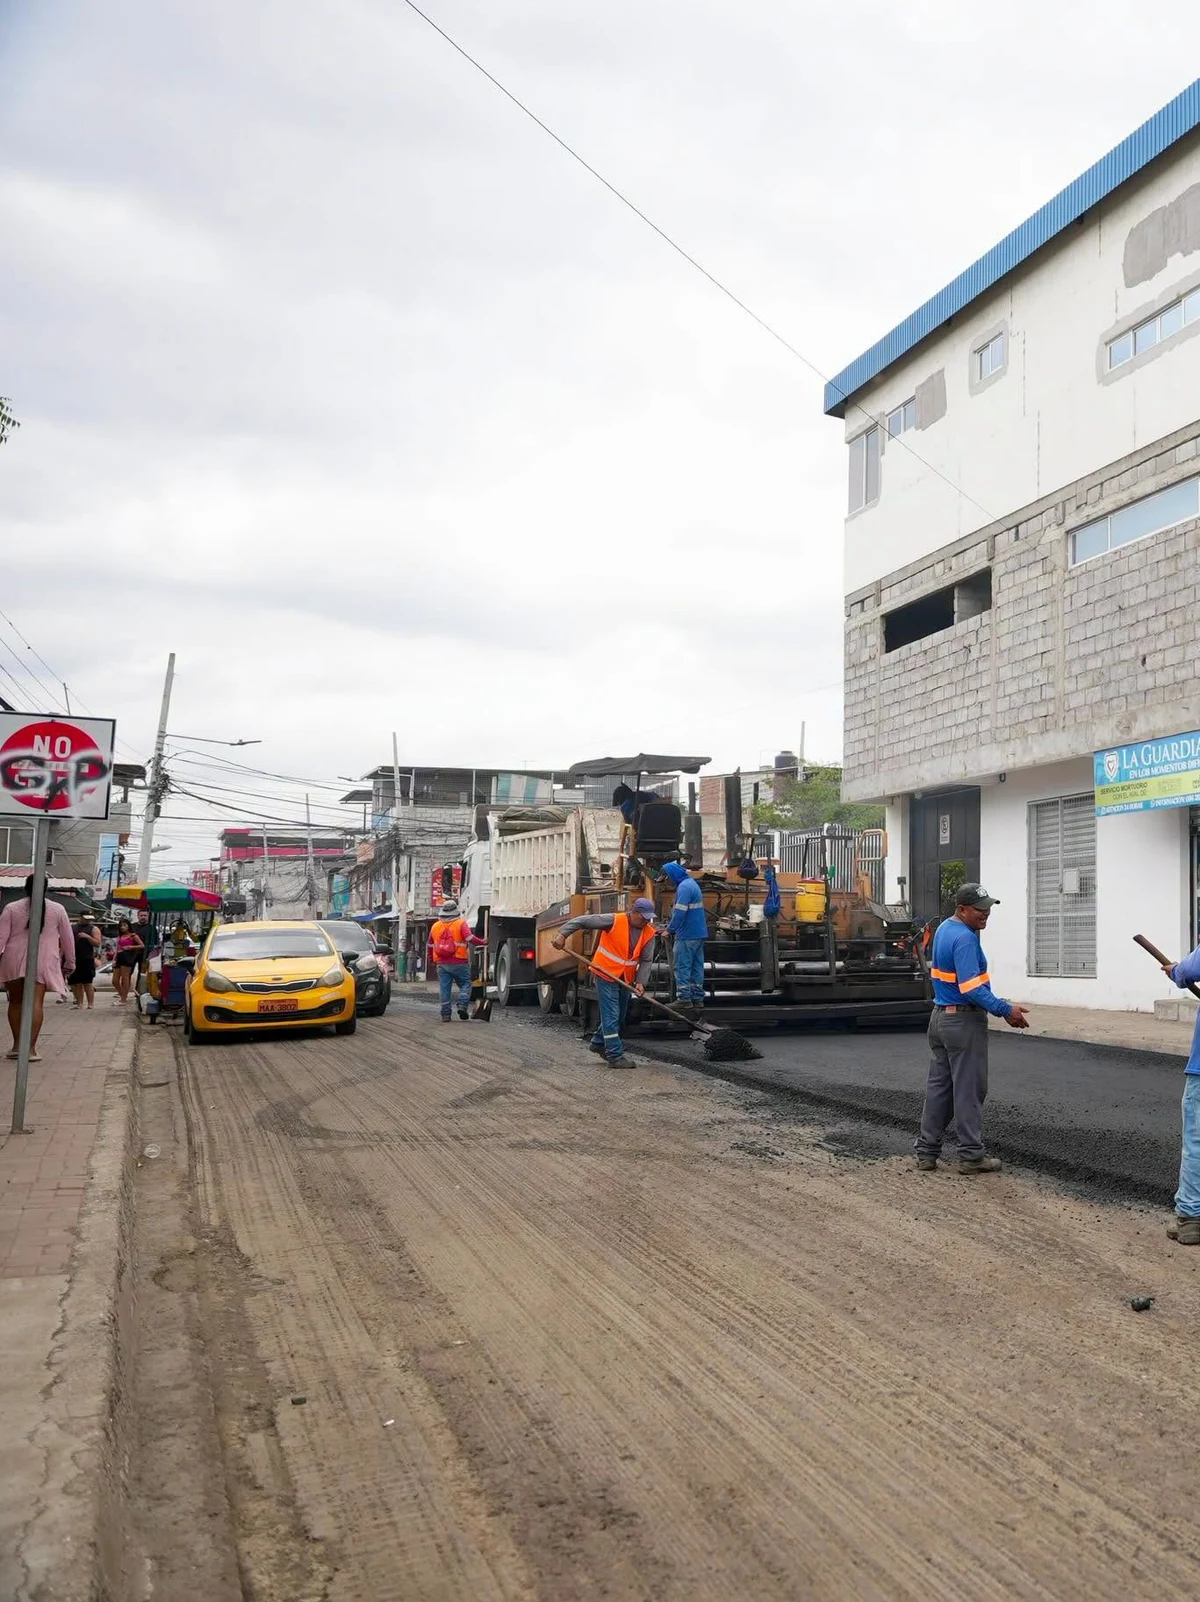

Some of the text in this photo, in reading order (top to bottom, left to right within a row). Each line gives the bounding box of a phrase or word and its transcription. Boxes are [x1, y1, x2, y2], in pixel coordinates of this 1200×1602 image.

[33, 734, 72, 760] NO
[1122, 748, 1139, 769] LA
[1129, 770, 1138, 779] EN
[1138, 767, 1151, 778] LOS
[1151, 763, 1187, 776] MOMENTOS
[1100, 786, 1120, 795] SERVICIO
